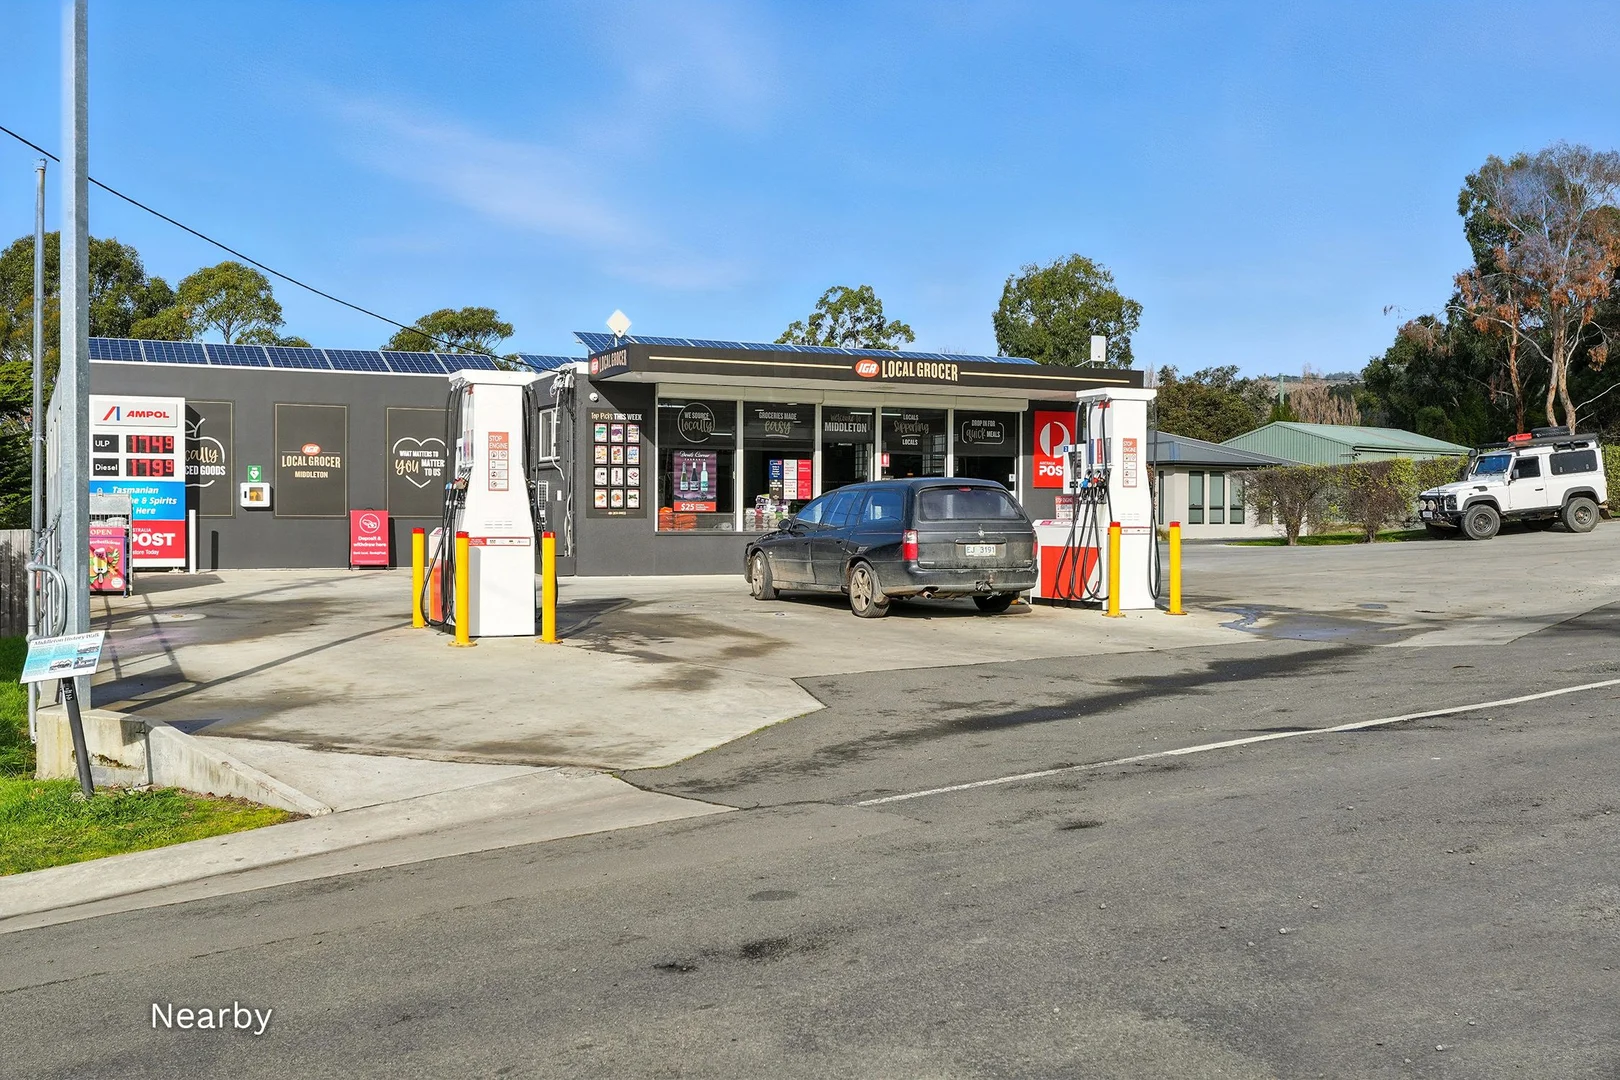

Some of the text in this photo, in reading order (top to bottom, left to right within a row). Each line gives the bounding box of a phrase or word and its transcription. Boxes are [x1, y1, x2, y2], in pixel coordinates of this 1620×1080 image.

[858, 360, 958, 381] IGA LOCAL GROCER
[126, 410, 170, 419] AMPOL
[591, 412, 600, 420] Top
[600, 412, 613, 420] Picks
[758, 412, 783, 420] GROCERIES
[682, 418, 712, 433] locally
[764, 420, 791, 434] easy
[824, 422, 867, 432] MIDDLETON
[966, 427, 986, 441] quick
[185, 446, 218, 463] cally
[95, 463, 118, 471] Diesel
[282, 456, 341, 468] LOCAL GROCER
[200, 465, 226, 475] GOODS
[395, 460, 419, 475] you
[424, 468, 432, 476] TO
[1039, 465, 1064, 476] POS
[112, 486, 159, 494] Tasmanian
[149, 496, 177, 505] Spirits
[681, 503, 695, 511] $25
[132, 532, 176, 546] POST
